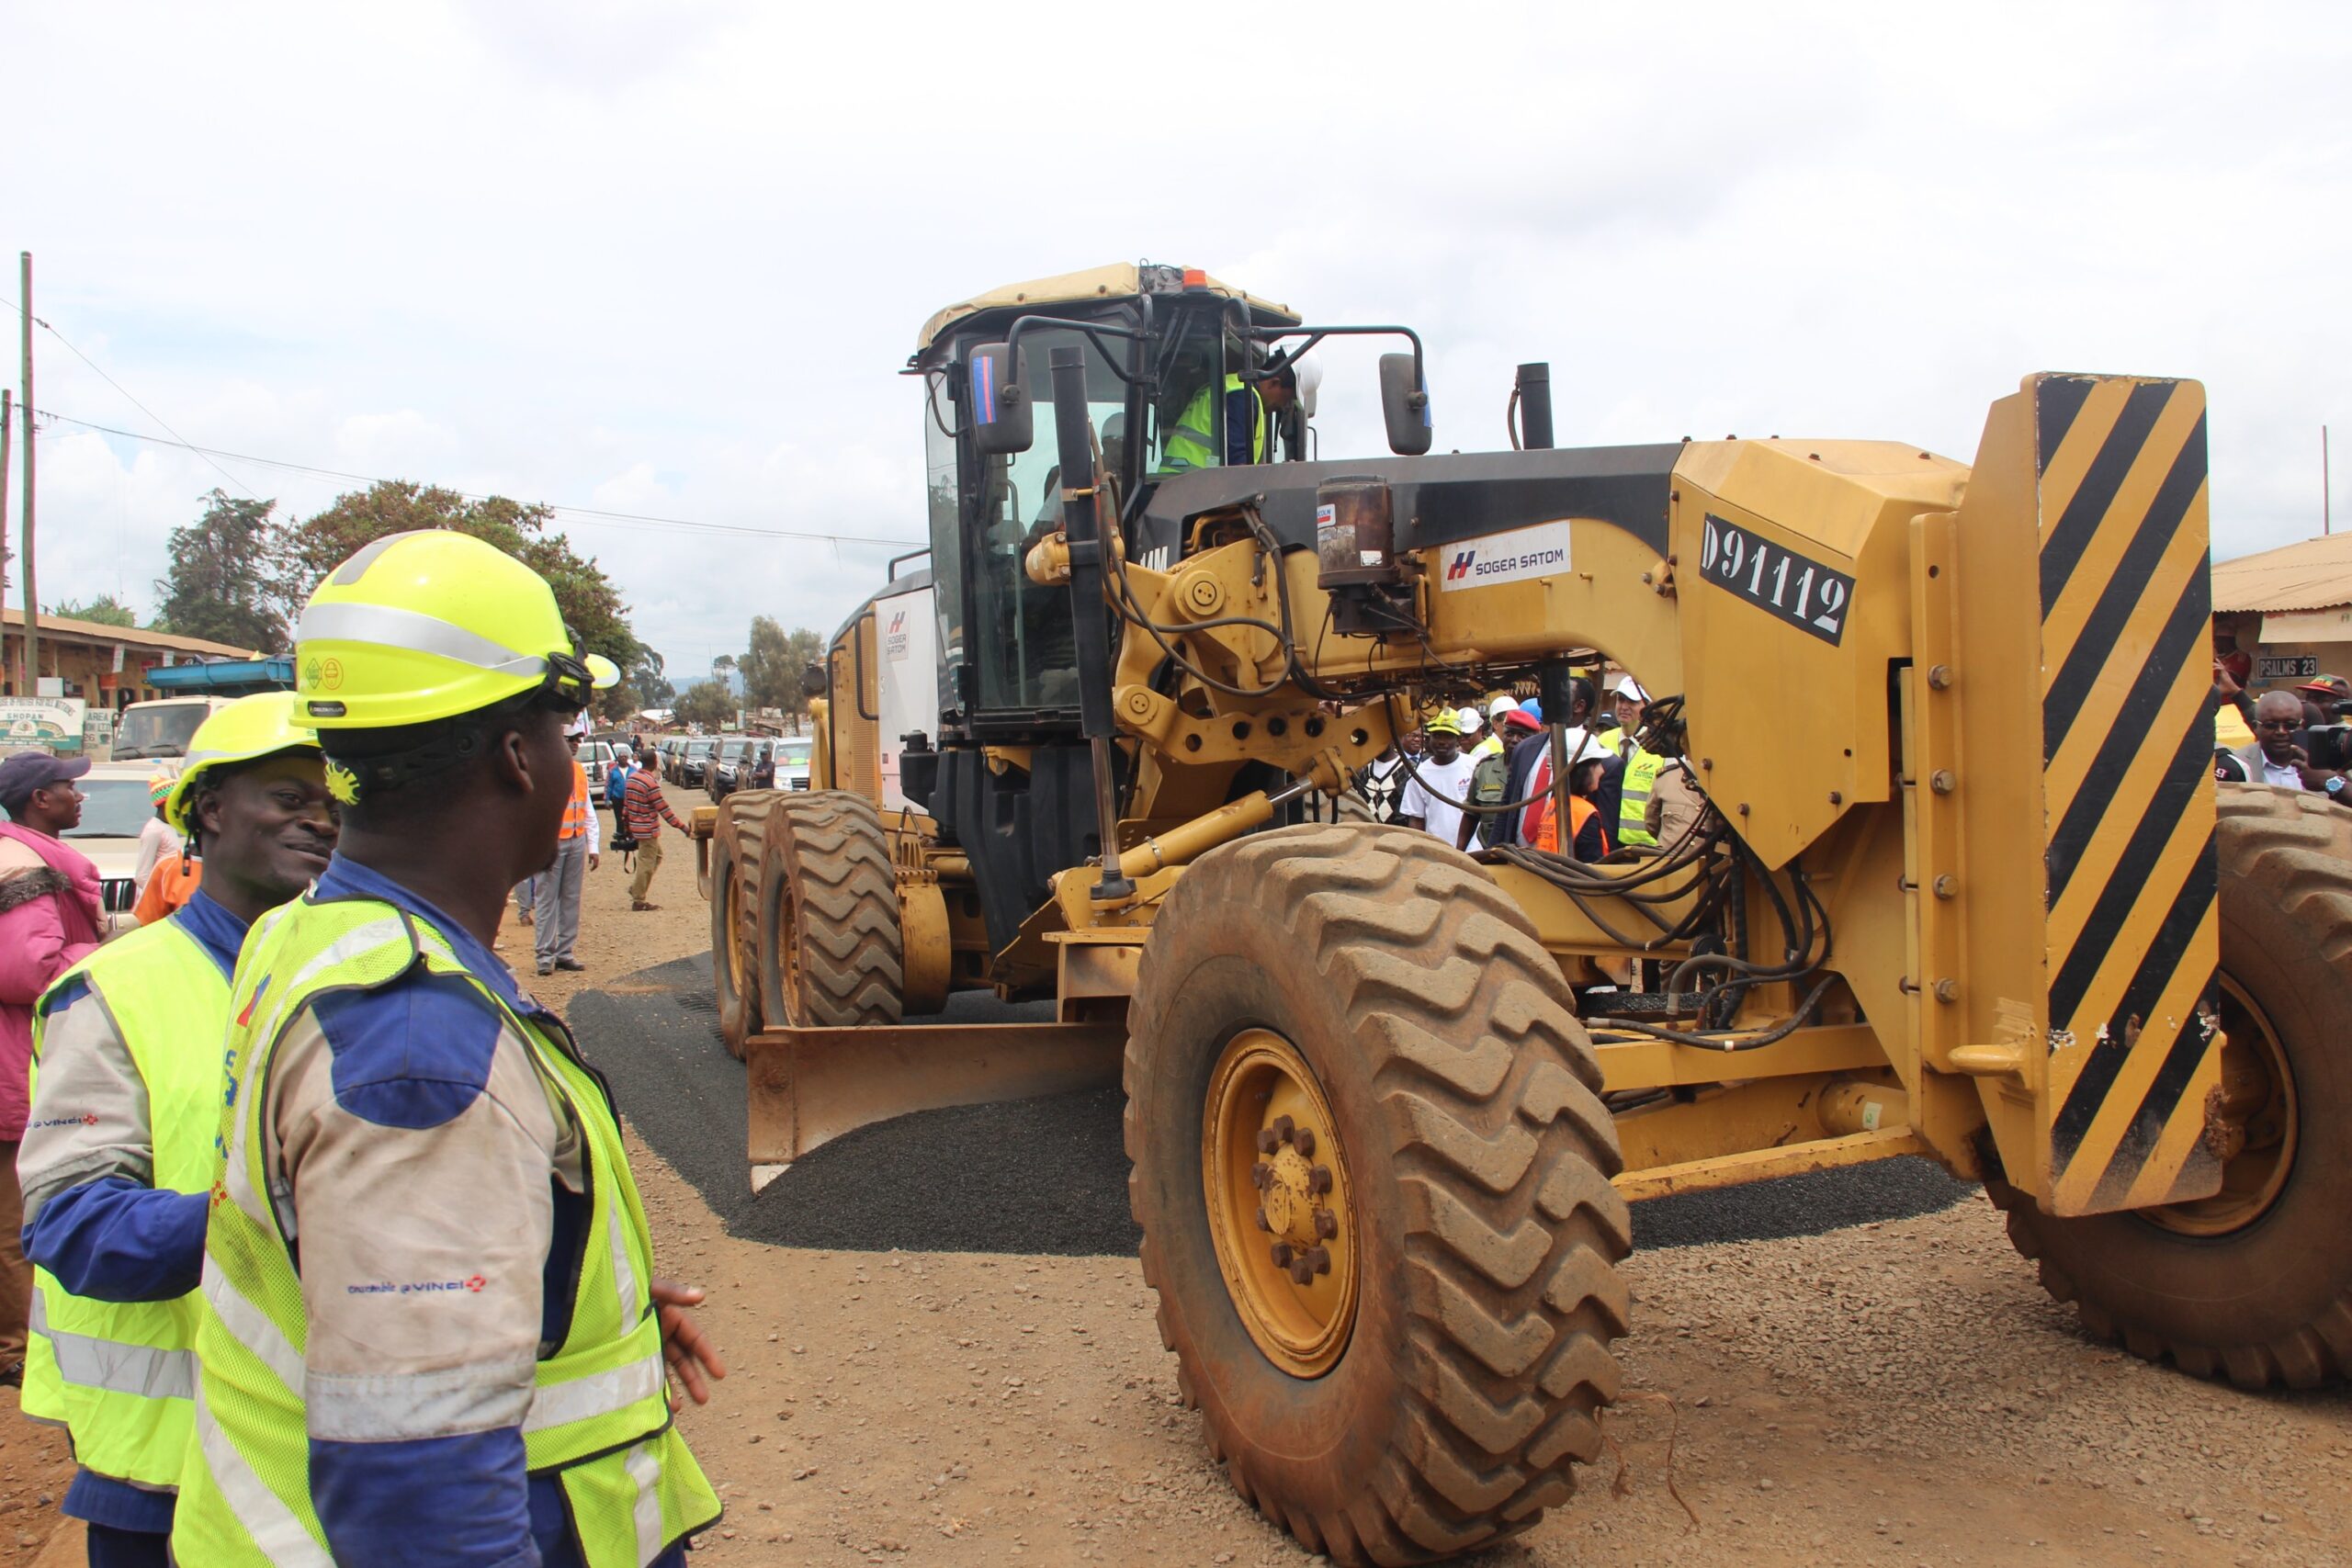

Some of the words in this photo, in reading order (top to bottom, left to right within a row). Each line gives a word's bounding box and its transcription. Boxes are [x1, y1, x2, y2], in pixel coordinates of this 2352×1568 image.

[1476, 558, 1517, 576] SOGEA
[1521, 548, 1564, 568] SATOM
[1702, 520, 1845, 634] D91112
[888, 644, 906, 655] SATOM
[2260, 660, 2297, 676] PSALMS
[2302, 660, 2315, 674] 23
[87, 712, 108, 720] AREA
